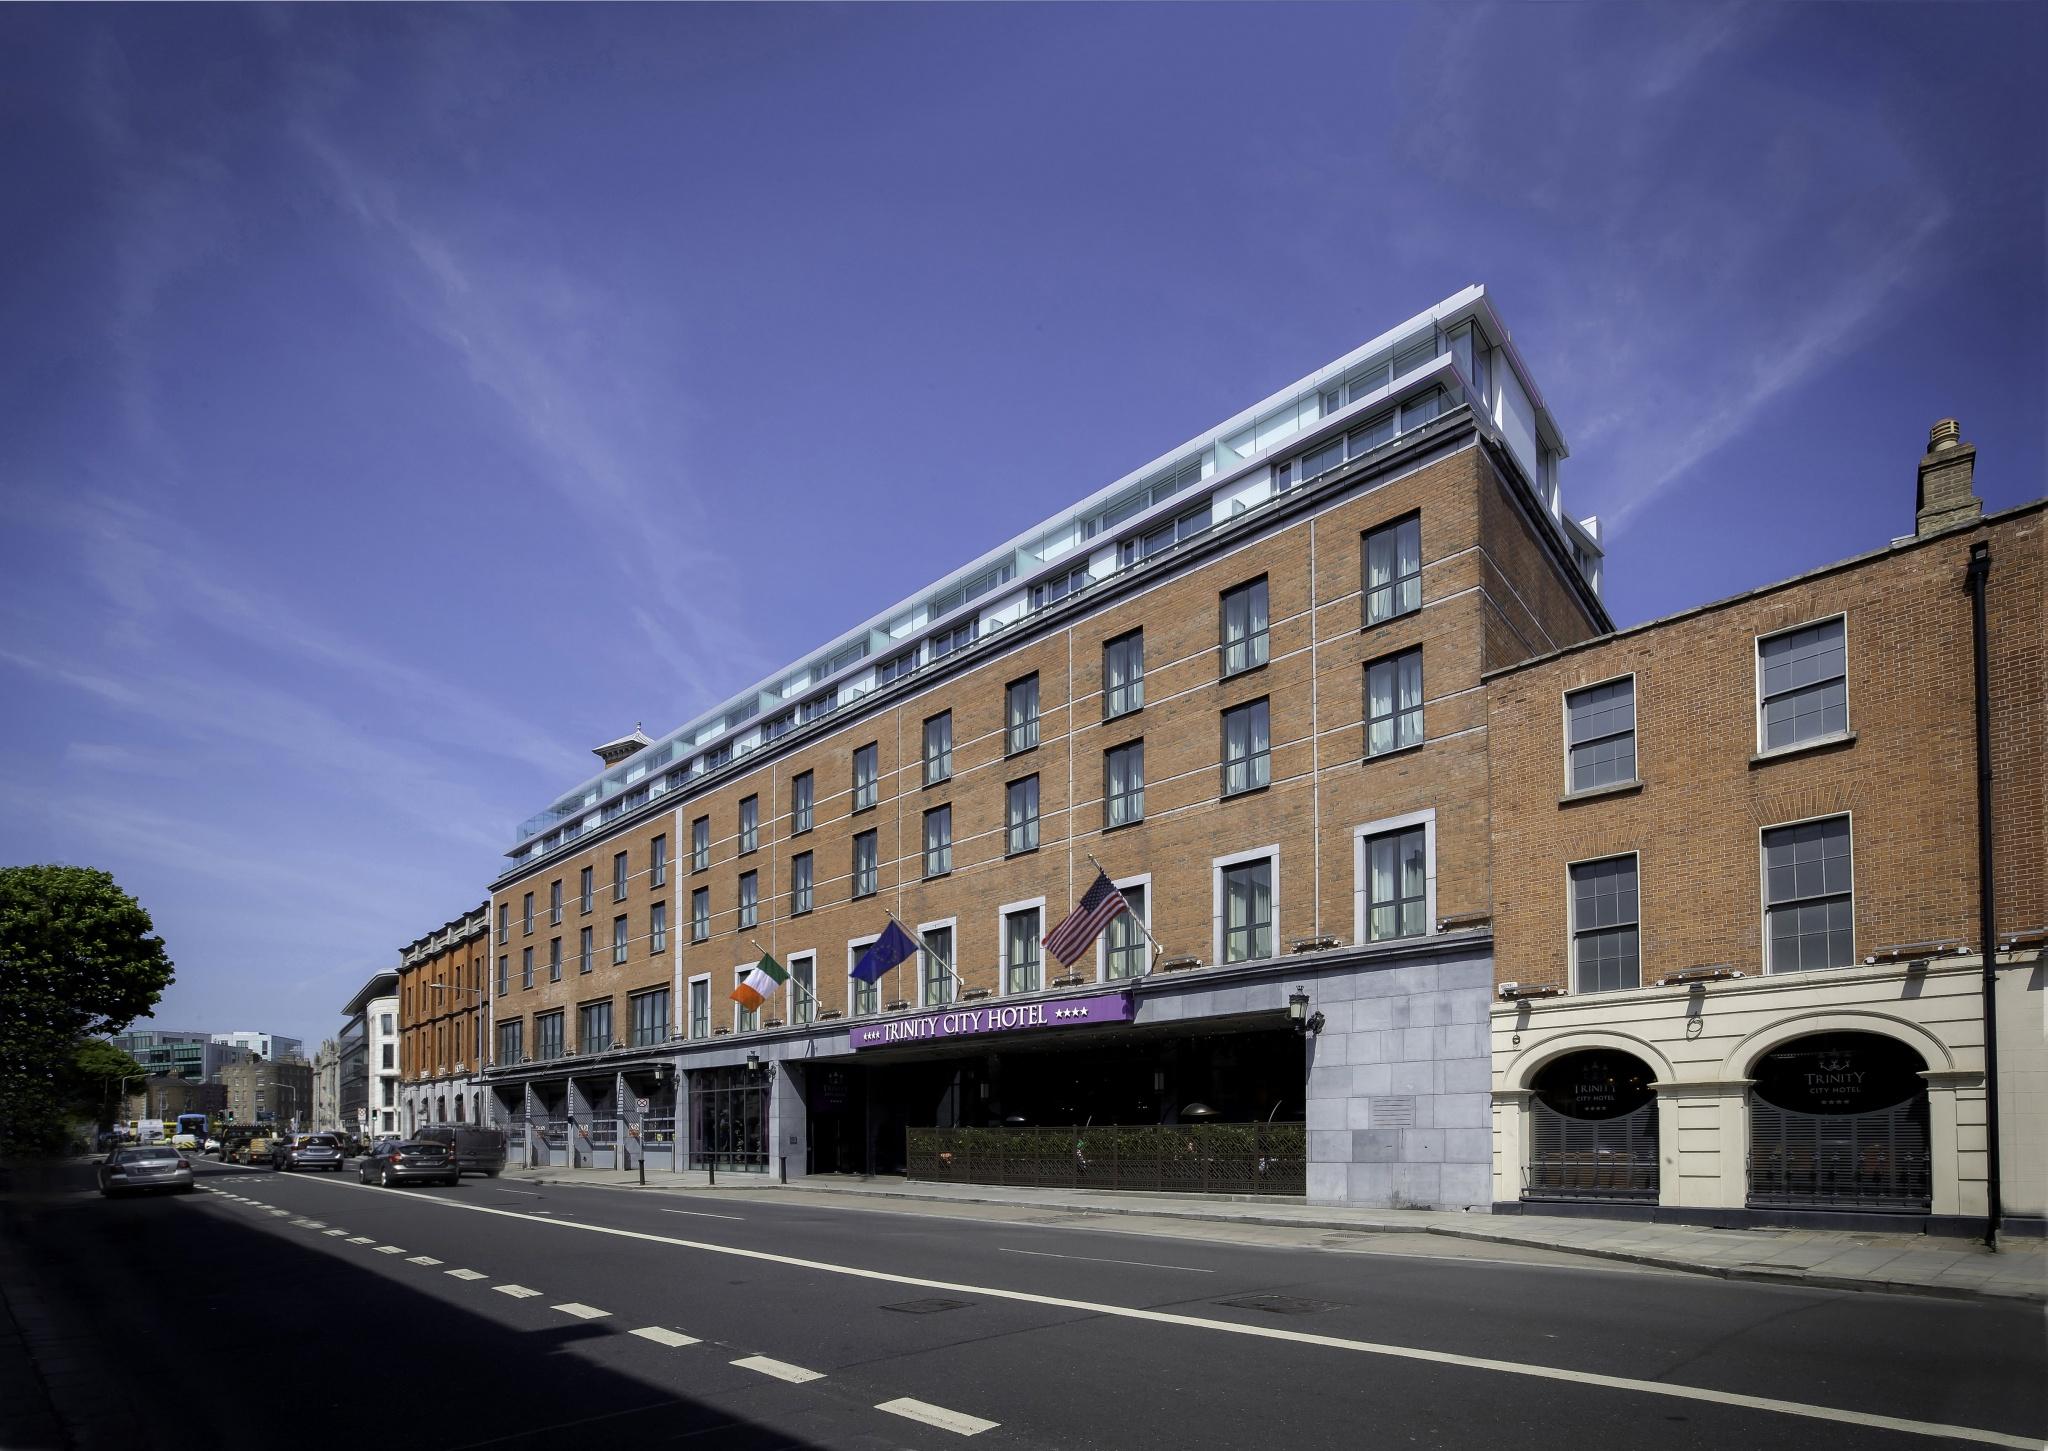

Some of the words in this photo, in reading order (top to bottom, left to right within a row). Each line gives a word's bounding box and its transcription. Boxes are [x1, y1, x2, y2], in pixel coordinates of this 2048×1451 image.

[884, 1017, 938, 1040] TRINITY
[943, 1011, 982, 1033] CITY
[988, 1005, 1047, 1029] HOTEL
[1804, 1072, 1866, 1085] TRINITY
